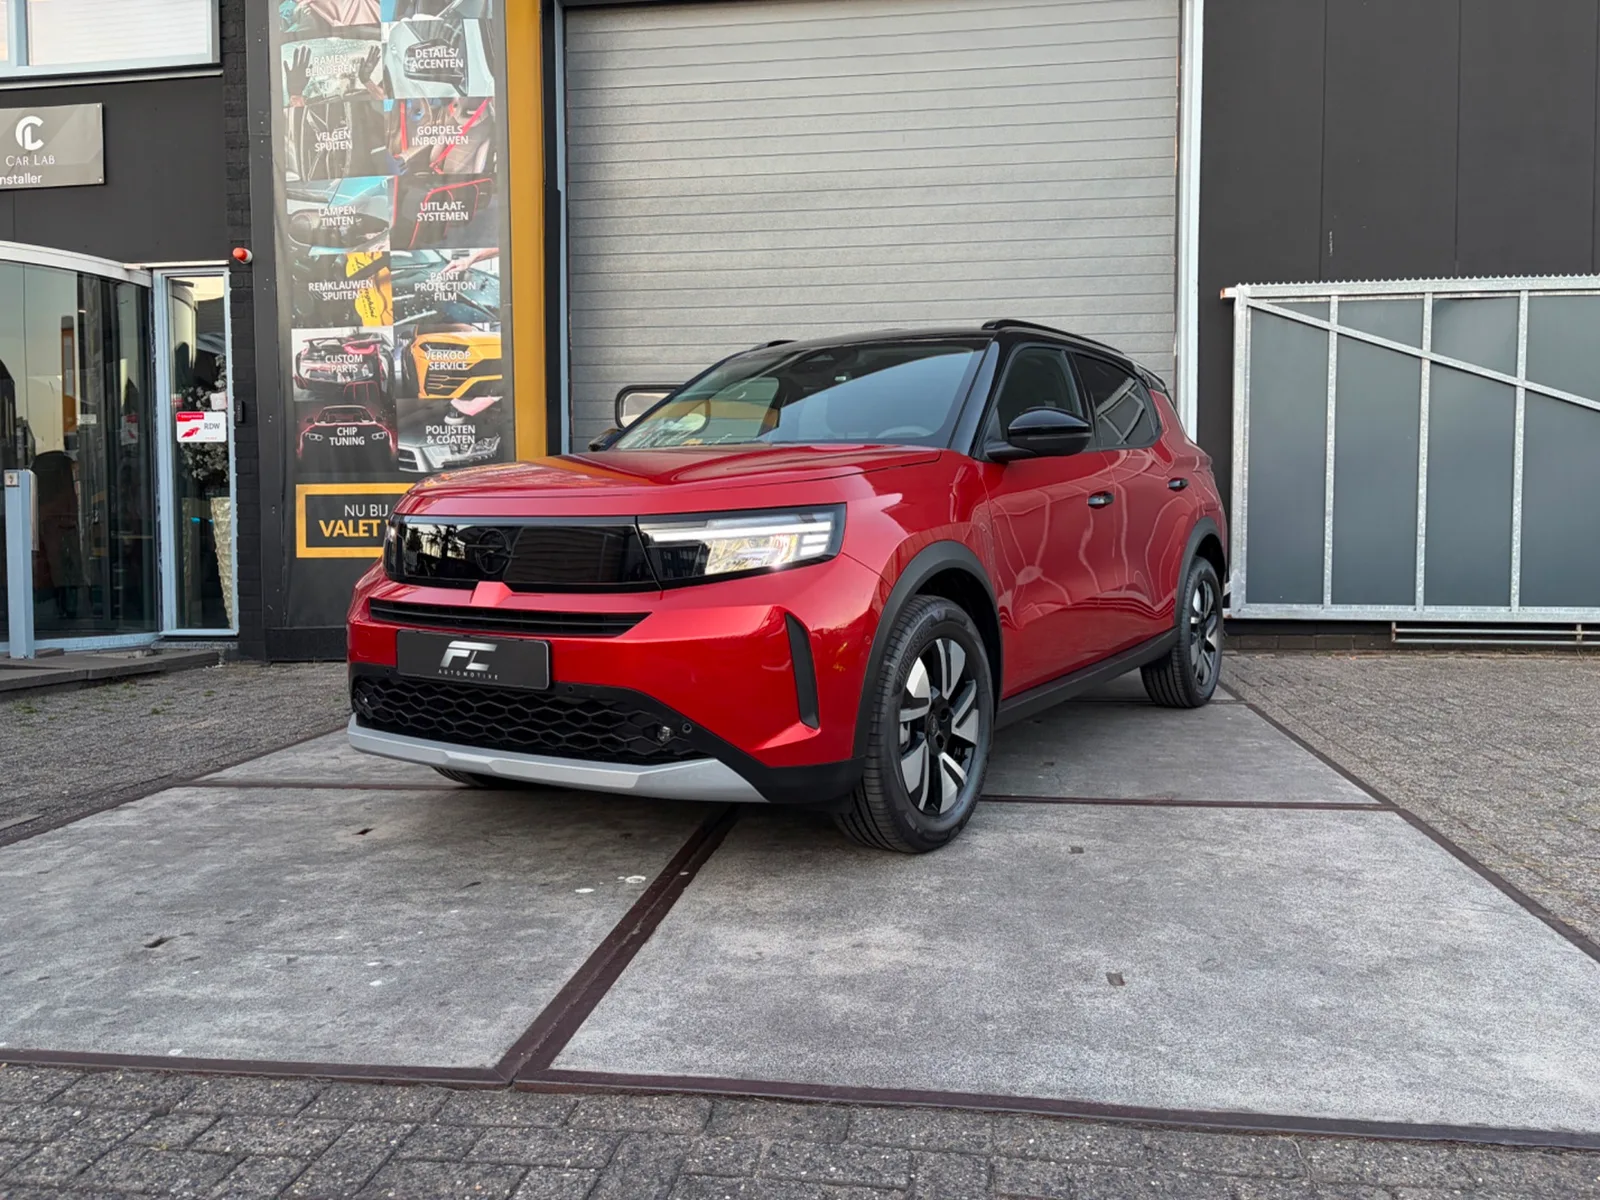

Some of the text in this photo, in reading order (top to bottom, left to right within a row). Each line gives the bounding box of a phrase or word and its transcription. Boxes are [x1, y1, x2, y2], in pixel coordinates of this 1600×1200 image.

[416, 48, 458, 58] DETAILS/
[412, 58, 463, 69] ACCENTEN
[316, 130, 351, 141] VELGEN
[417, 125, 463, 136] GORDELS
[315, 141, 352, 151] SPUITEN
[412, 135, 469, 146] INBOUWEN
[318, 206, 356, 217] LAMPEN
[420, 201, 465, 212] UITLAAT-
[321, 216, 354, 226] TINTEN
[417, 211, 469, 222] SYSTEMEN
[430, 271, 459, 281] PAINT
[308, 280, 373, 291] REMKLAUWEN
[415, 281, 476, 292] PROTECTION
[322, 291, 360, 301] SPUITEN
[434, 291, 457, 301] FILM
[325, 354, 363, 364] CUSTOM
[425, 350, 471, 361] VERKOOP
[331, 364, 358, 373] PARTS
[429, 361, 467, 371] SERVICE
[204, 422, 220, 430] RDW
[336, 427, 358, 436] CHIP
[426, 425, 476, 436] POLIJSTEN
[329, 436, 365, 446] TUNING
[426, 434, 475, 444] & COATEN
[344, 503, 389, 517] NU BIJ
[318, 519, 381, 538] VALET
[438, 669, 499, 680] AUTOMOTIVE
